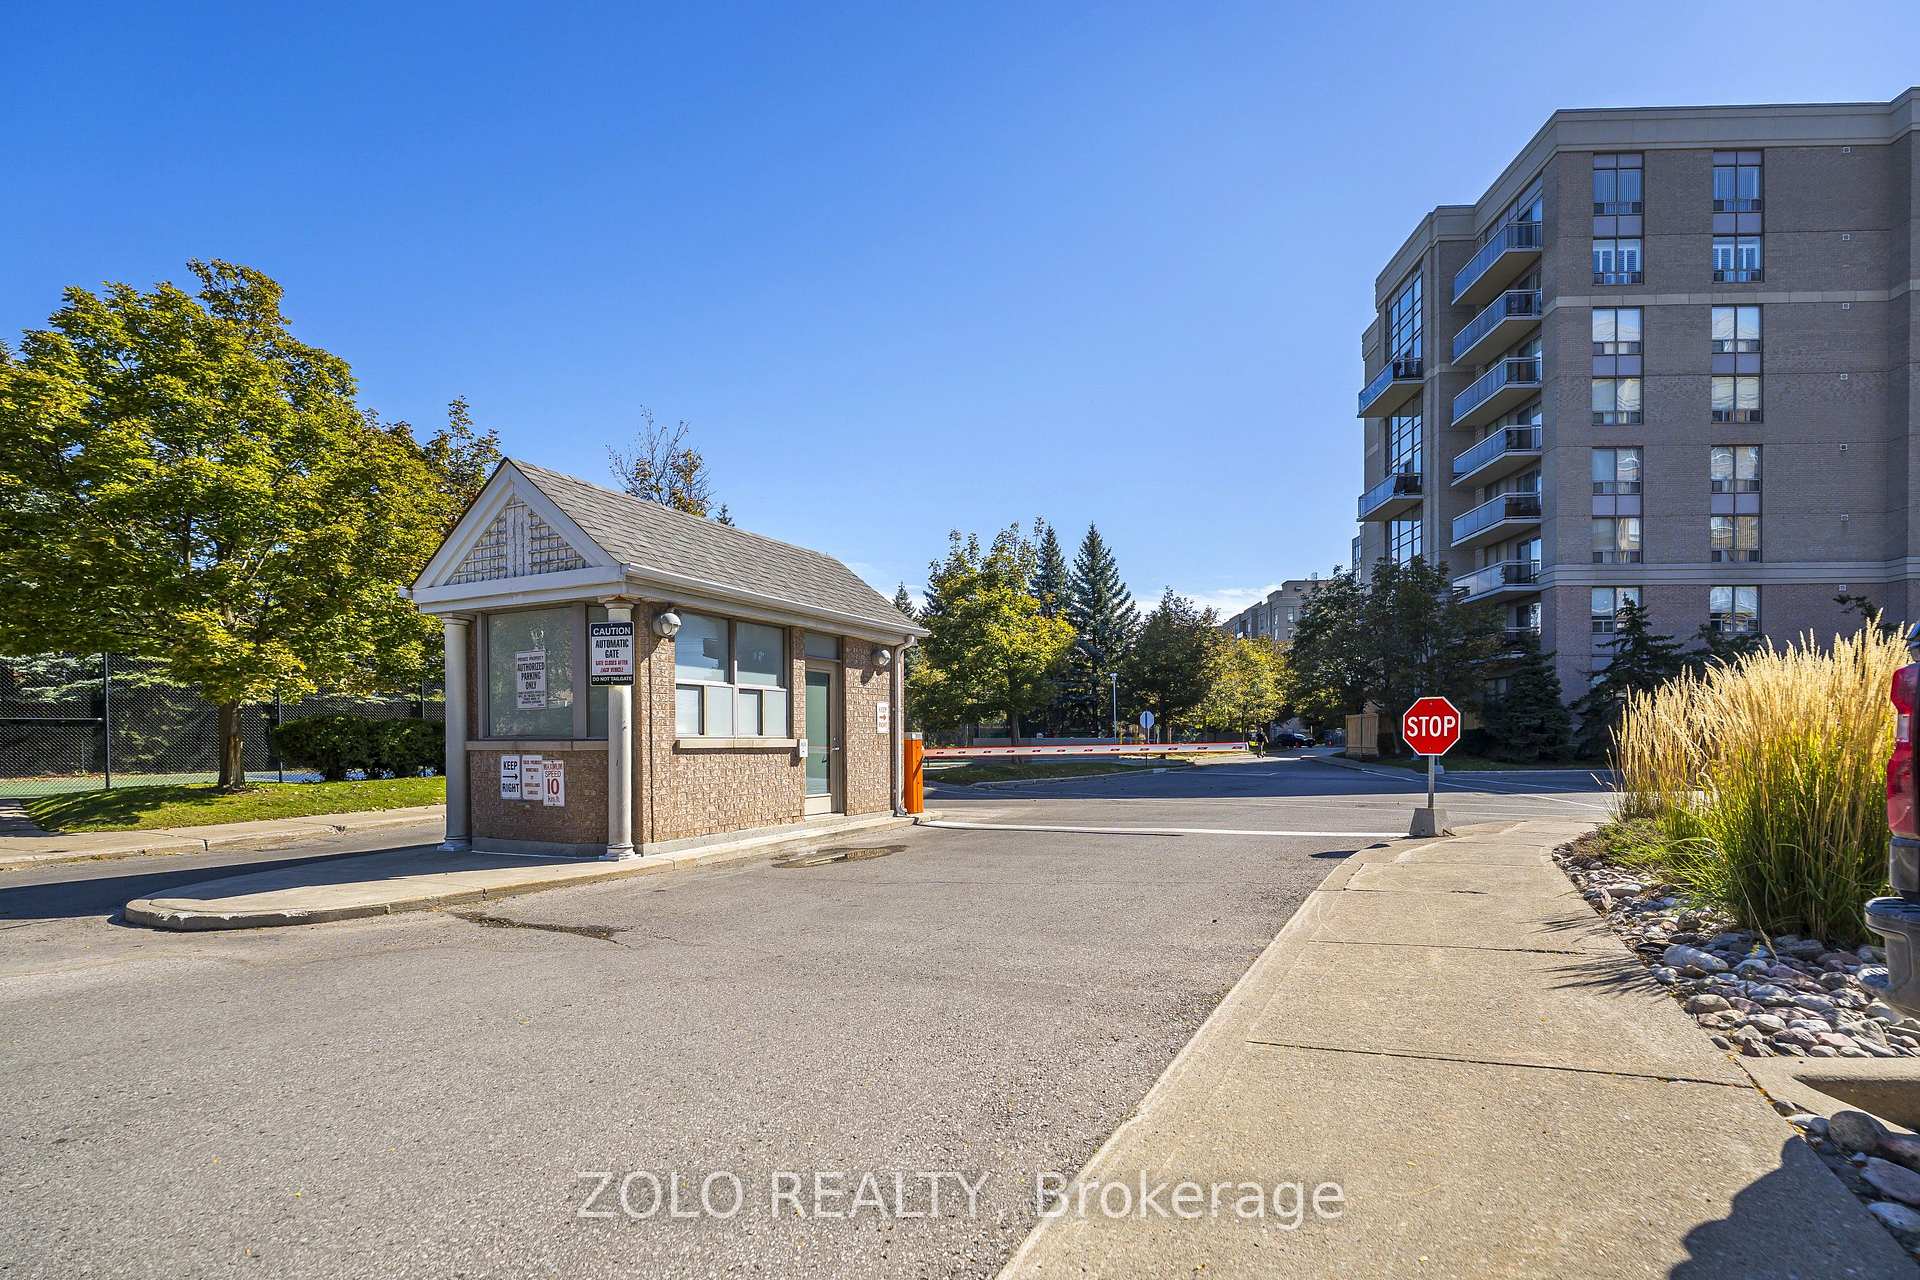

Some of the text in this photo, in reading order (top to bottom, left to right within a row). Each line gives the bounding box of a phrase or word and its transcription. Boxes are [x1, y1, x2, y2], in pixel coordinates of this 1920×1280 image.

[593, 627, 631, 635] CAUTION
[595, 639, 629, 648] AUTOMATIC
[605, 650, 620, 658] GATE
[517, 662, 545, 671] AUTHORIZED
[520, 672, 541, 680] PARKING
[525, 681, 537, 690] ONLY
[1407, 715, 1456, 737] STOP
[503, 761, 518, 770] KEEP
[502, 783, 519, 792] RIGHT
[547, 778, 560, 795] 10
